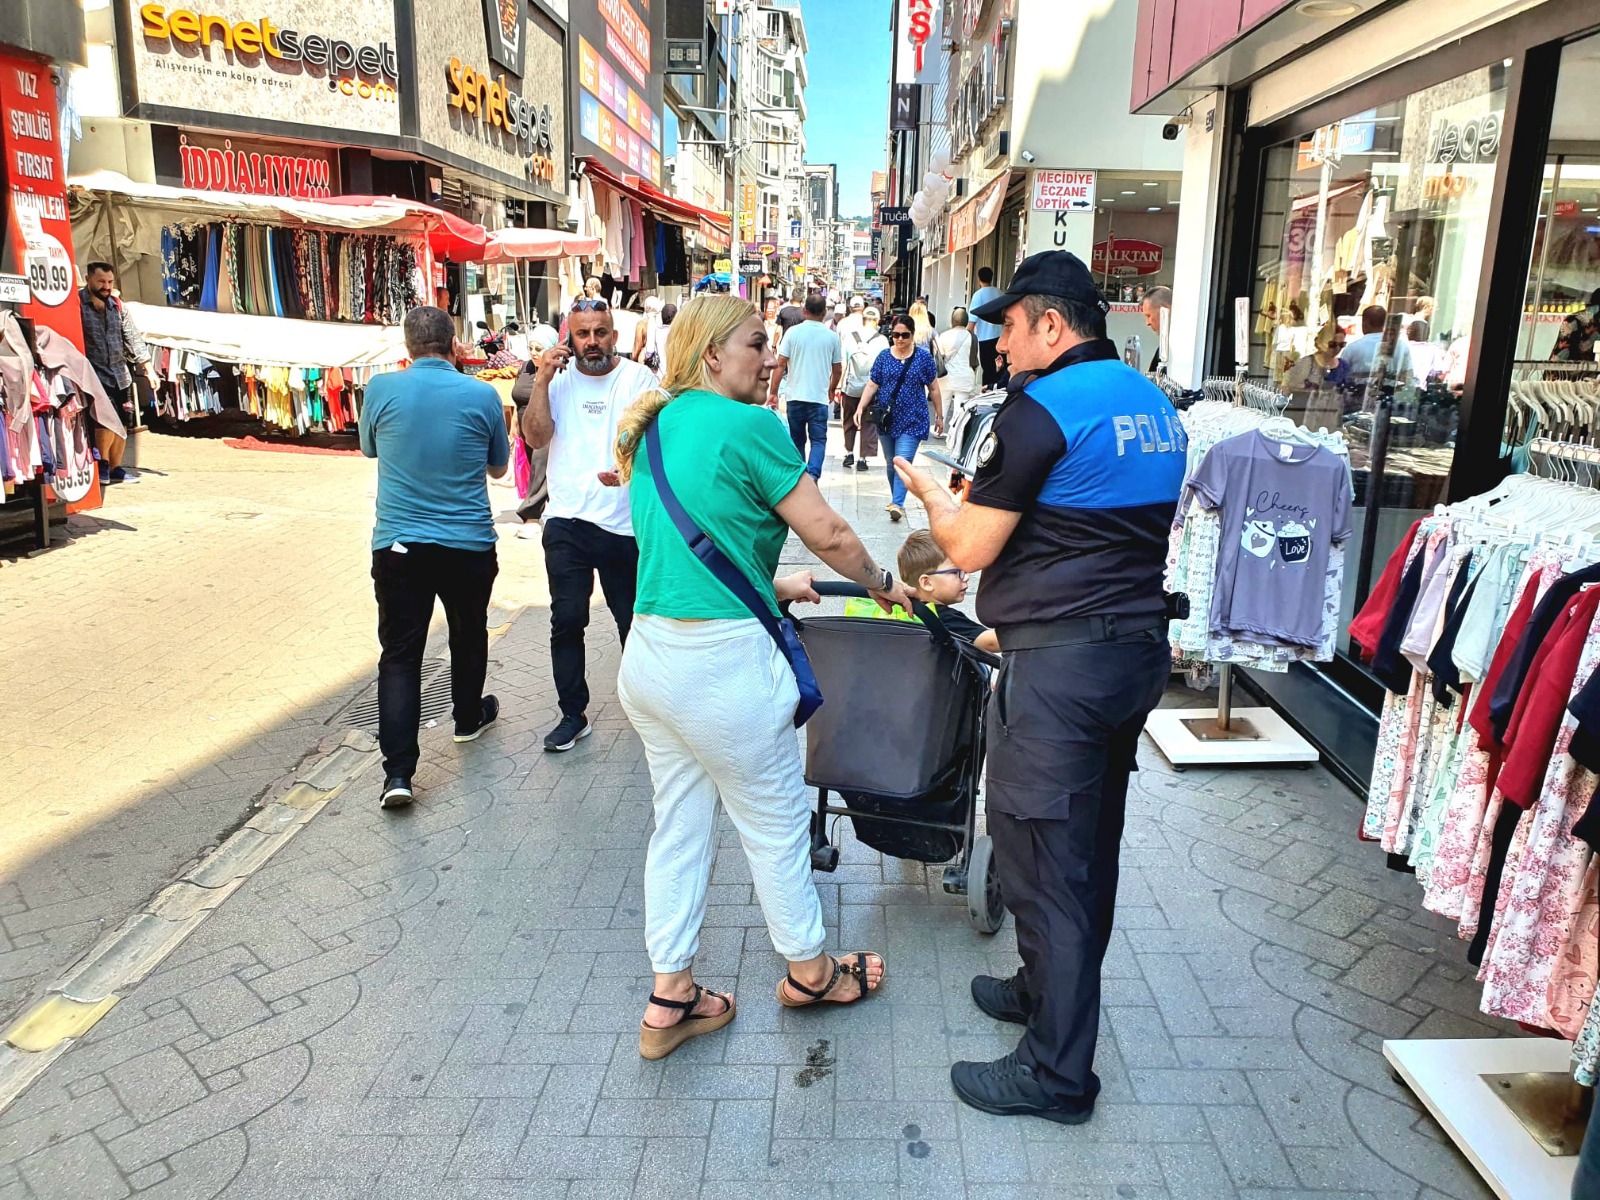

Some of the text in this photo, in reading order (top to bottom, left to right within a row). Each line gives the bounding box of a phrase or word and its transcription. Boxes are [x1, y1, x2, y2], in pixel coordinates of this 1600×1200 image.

[141, 3, 399, 78] senetsepet
[17, 70, 39, 99] YAZ
[155, 59, 292, 89] Alışverişin en kolay adresi
[328, 77, 397, 103] .com
[448, 56, 553, 153] senetsepet
[11, 109, 53, 141] ŞENLİĞİ
[16, 151, 54, 181] FIRSAT
[1037, 170, 1093, 185] MECİDİYE
[1041, 185, 1087, 197] ECZANE
[1093, 249, 1159, 263] HALKTAN
[1256, 490, 1309, 518] Cheers
[1285, 541, 1306, 556] Love
